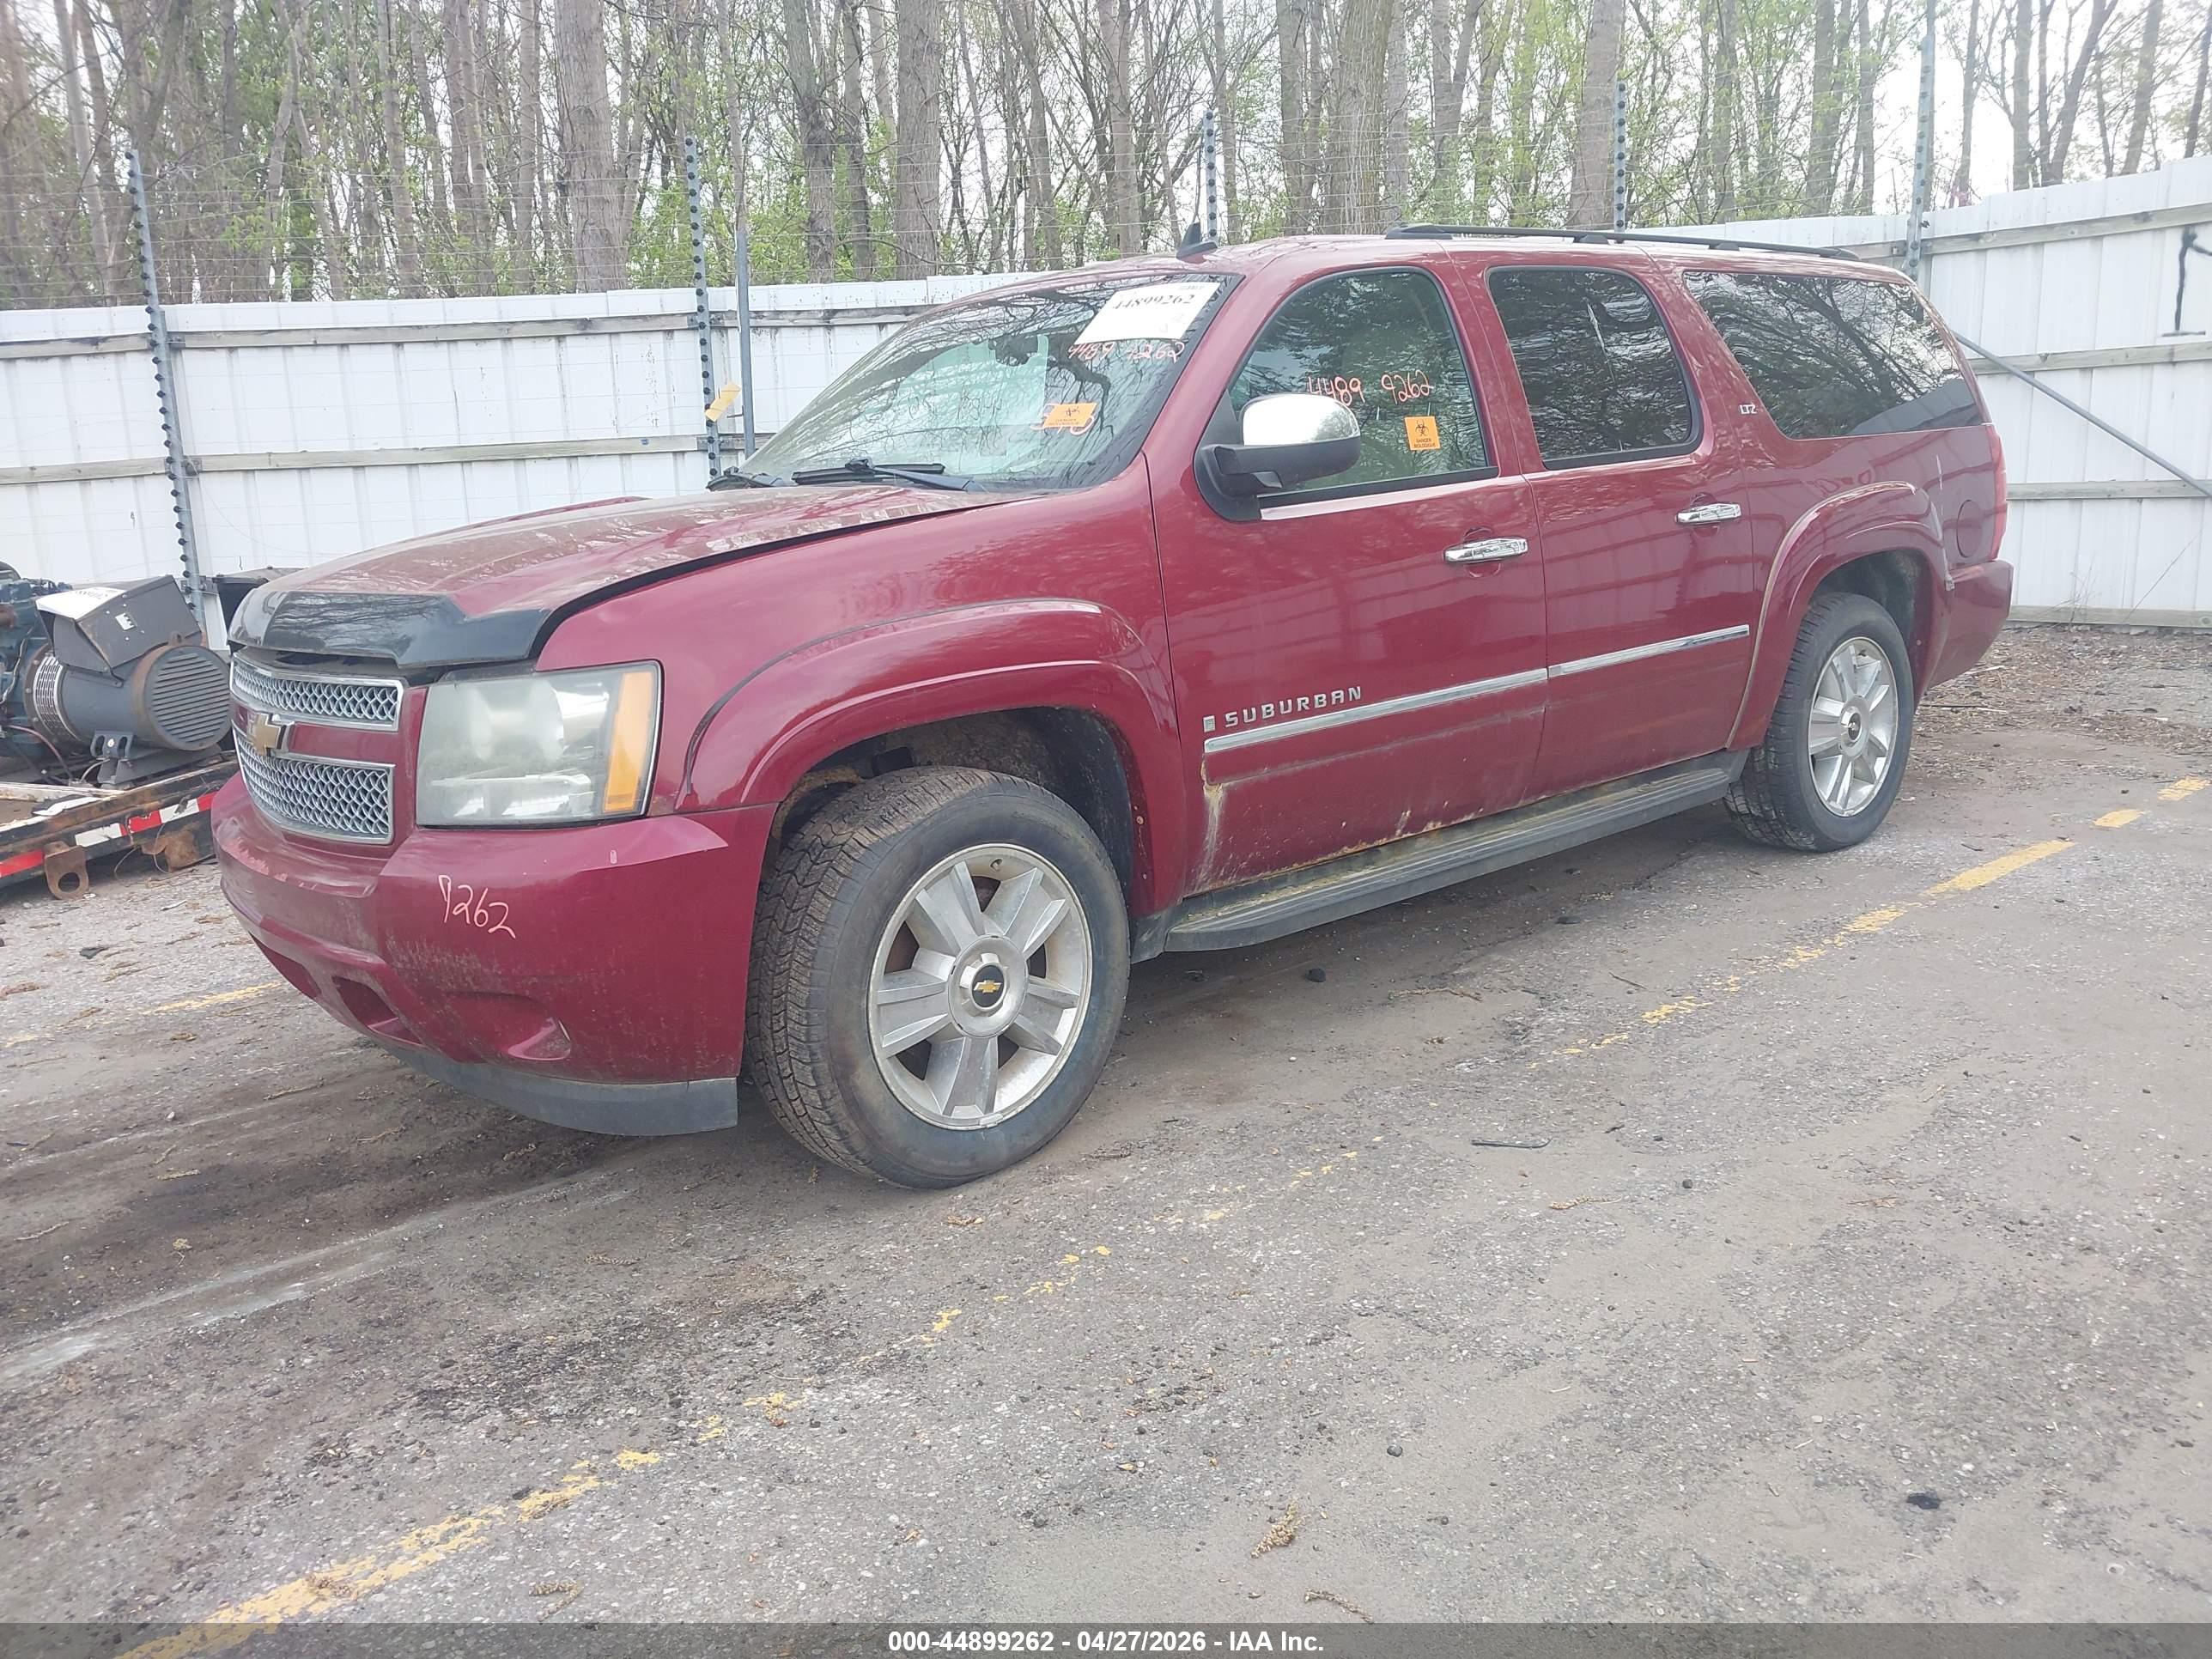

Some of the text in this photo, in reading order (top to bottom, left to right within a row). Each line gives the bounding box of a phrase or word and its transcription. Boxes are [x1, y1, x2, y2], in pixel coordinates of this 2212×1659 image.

[1308, 369, 1435, 407] 4489 9262
[1224, 685, 1362, 728] SUBURBAN
[438, 875, 517, 939] 9262
